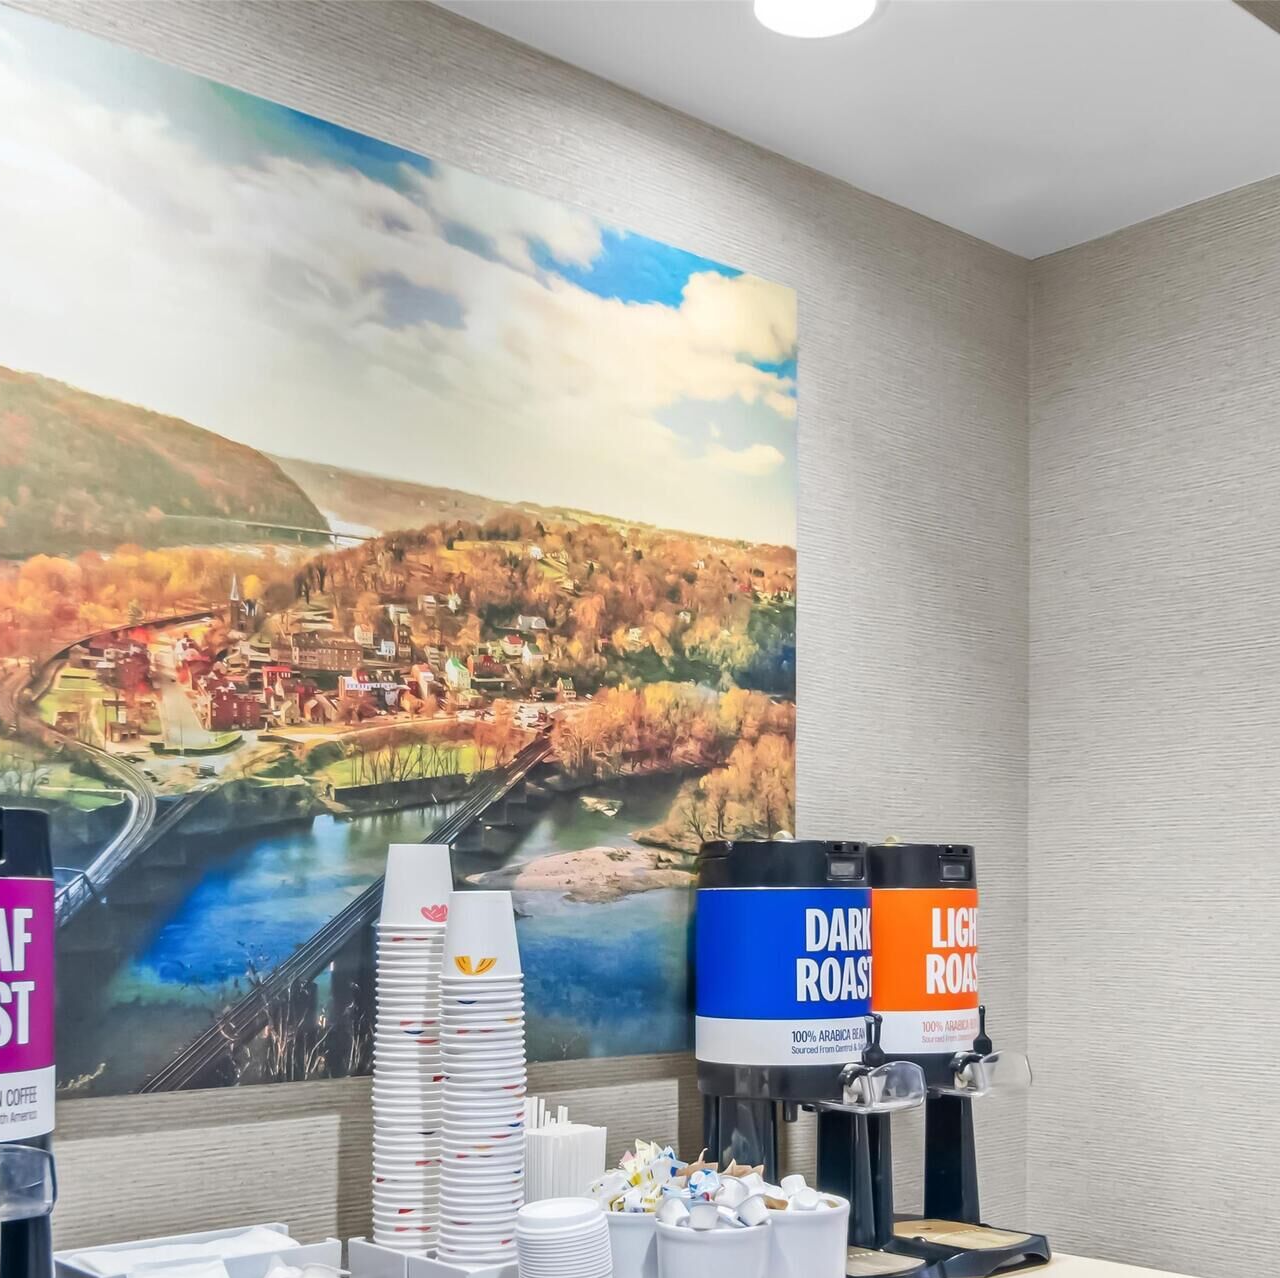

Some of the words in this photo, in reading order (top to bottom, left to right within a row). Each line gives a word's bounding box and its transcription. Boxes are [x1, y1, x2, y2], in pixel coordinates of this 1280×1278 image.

[805, 908, 872, 952] DARK
[932, 907, 977, 948] LIGH
[796, 956, 873, 1002] ROAST
[926, 953, 977, 994] ROAS
[790, 1030, 817, 1043] 100%
[819, 1028, 851, 1042] ARABICA
[922, 1020, 943, 1033] 100%
[791, 1045, 819, 1055] Sourced
[820, 1044, 835, 1054] From
[6, 1085, 37, 1107] COFFEE
